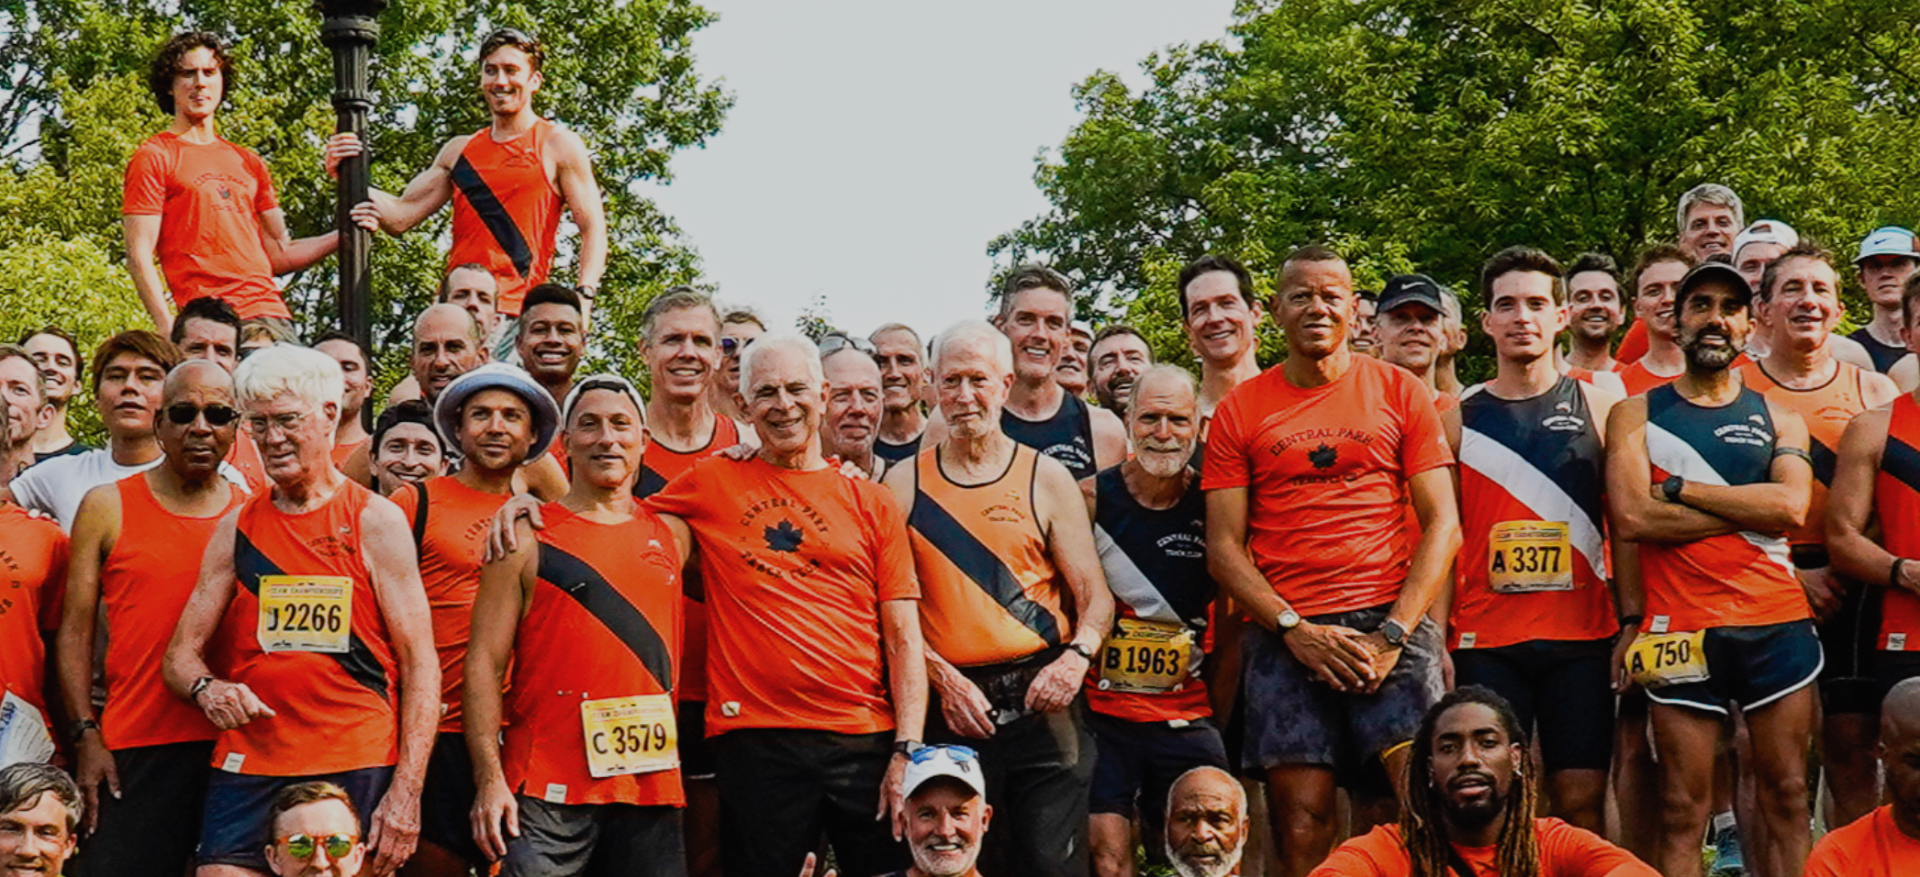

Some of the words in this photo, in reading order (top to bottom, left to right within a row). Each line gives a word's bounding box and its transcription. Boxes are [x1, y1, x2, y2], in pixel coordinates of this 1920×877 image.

[1270, 427, 1333, 456] CENTRAL
[1338, 427, 1374, 446] PARK
[740, 498, 796, 527] CENTRAL
[802, 505, 829, 532] PARK
[1491, 549, 1507, 573] A
[1512, 546, 1562, 573] 3377
[282, 602, 342, 634] 2266
[1105, 646, 1122, 670] B
[1125, 645, 1180, 676] 1963
[1632, 651, 1646, 673] A
[1653, 639, 1691, 669] 750
[592, 732, 609, 755] C
[612, 722, 667, 755] 3579
